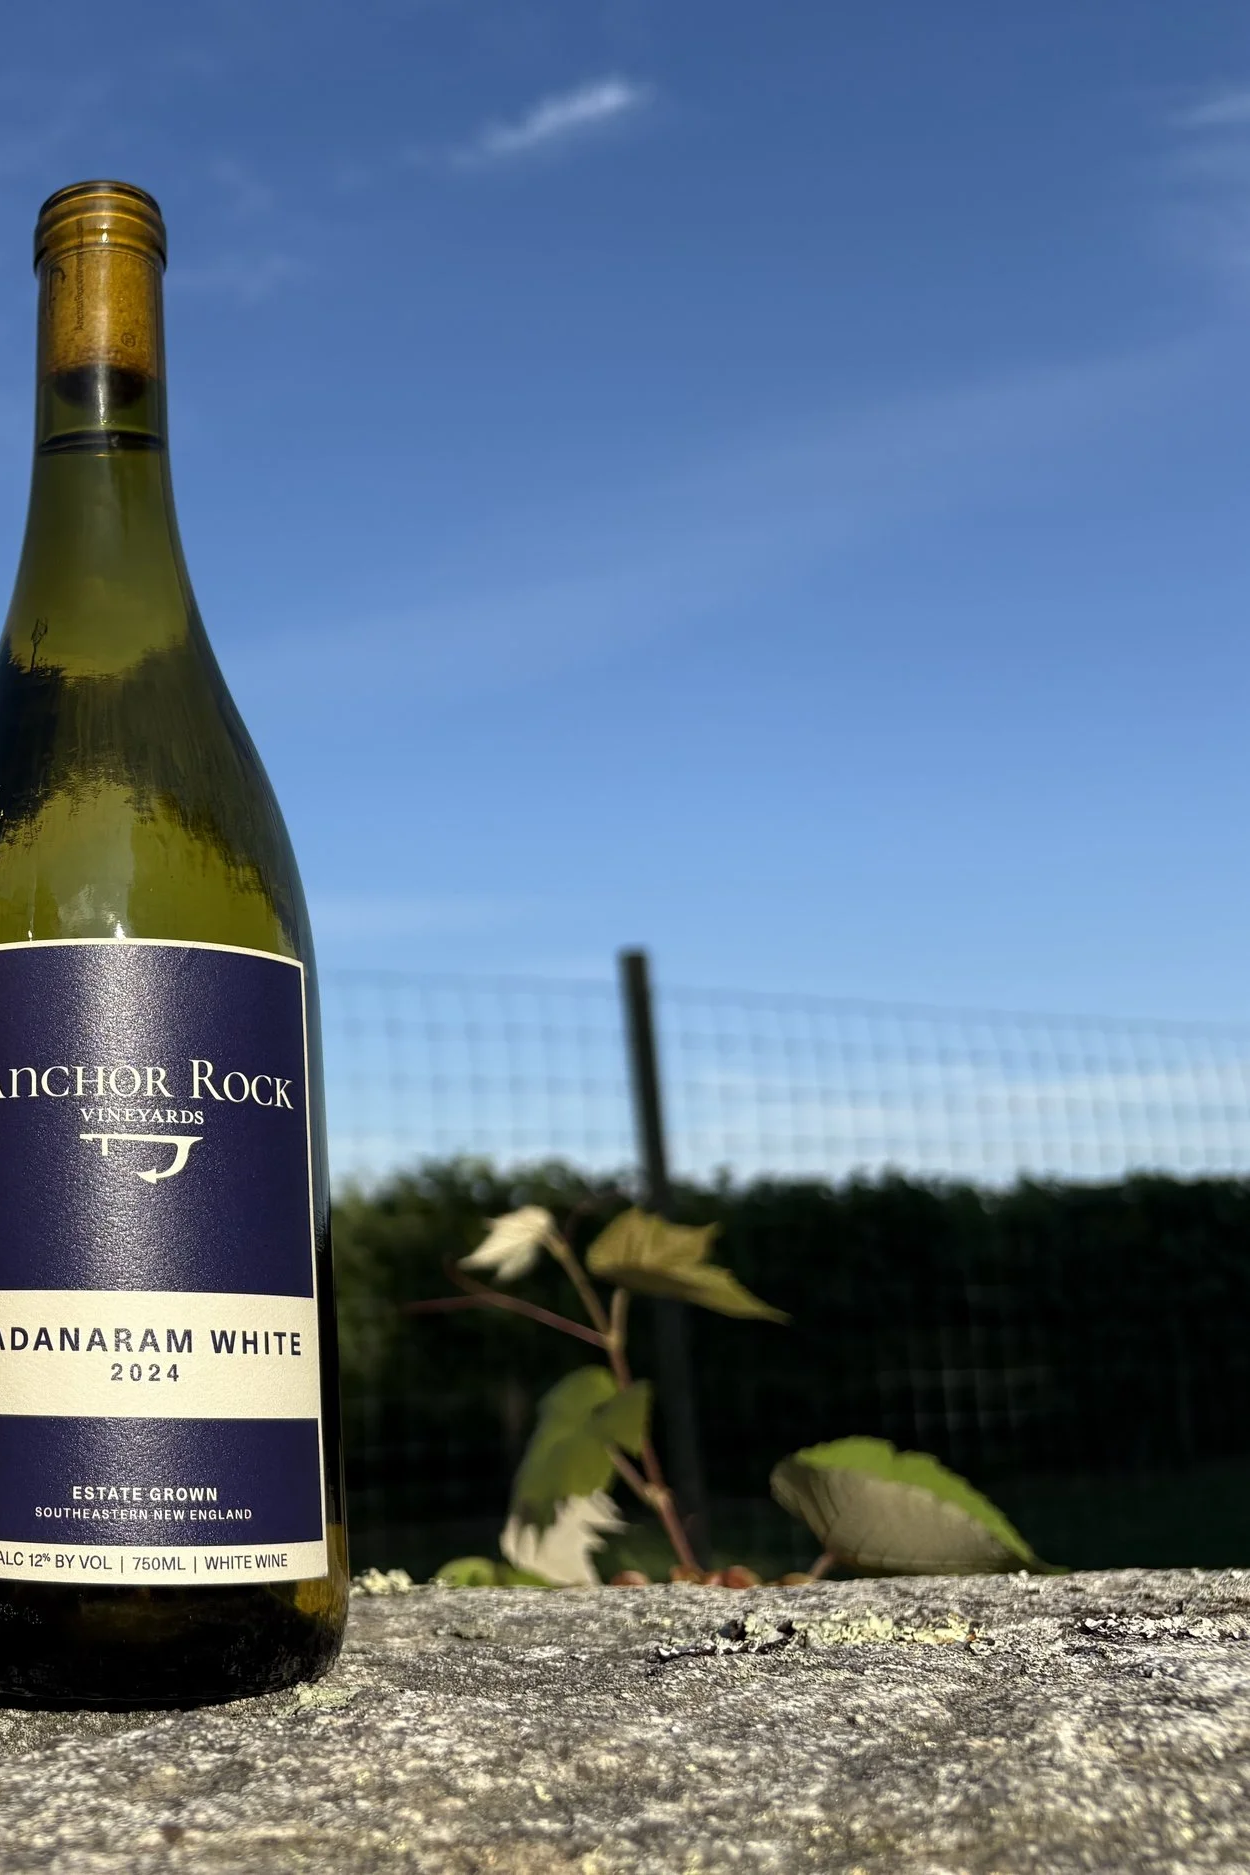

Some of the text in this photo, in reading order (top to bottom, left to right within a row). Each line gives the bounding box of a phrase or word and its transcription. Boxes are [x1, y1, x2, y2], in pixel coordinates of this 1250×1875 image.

[189, 1059, 295, 1110] ROCK
[79, 1107, 204, 1125] VINEYARDS
[210, 1329, 302, 1356] WHITE
[110, 1363, 180, 1382] 2024
[72, 1486, 218, 1502] ESTATE GROWN
[34, 1506, 253, 1521] SOUTHEASTERN NEW ENGLAND
[28, 1552, 51, 1568] 12%
[55, 1553, 77, 1569] BY
[79, 1554, 113, 1570] VOL
[132, 1556, 186, 1571] 750ML
[204, 1555, 252, 1571] WHITE
[254, 1553, 288, 1569] WINE
